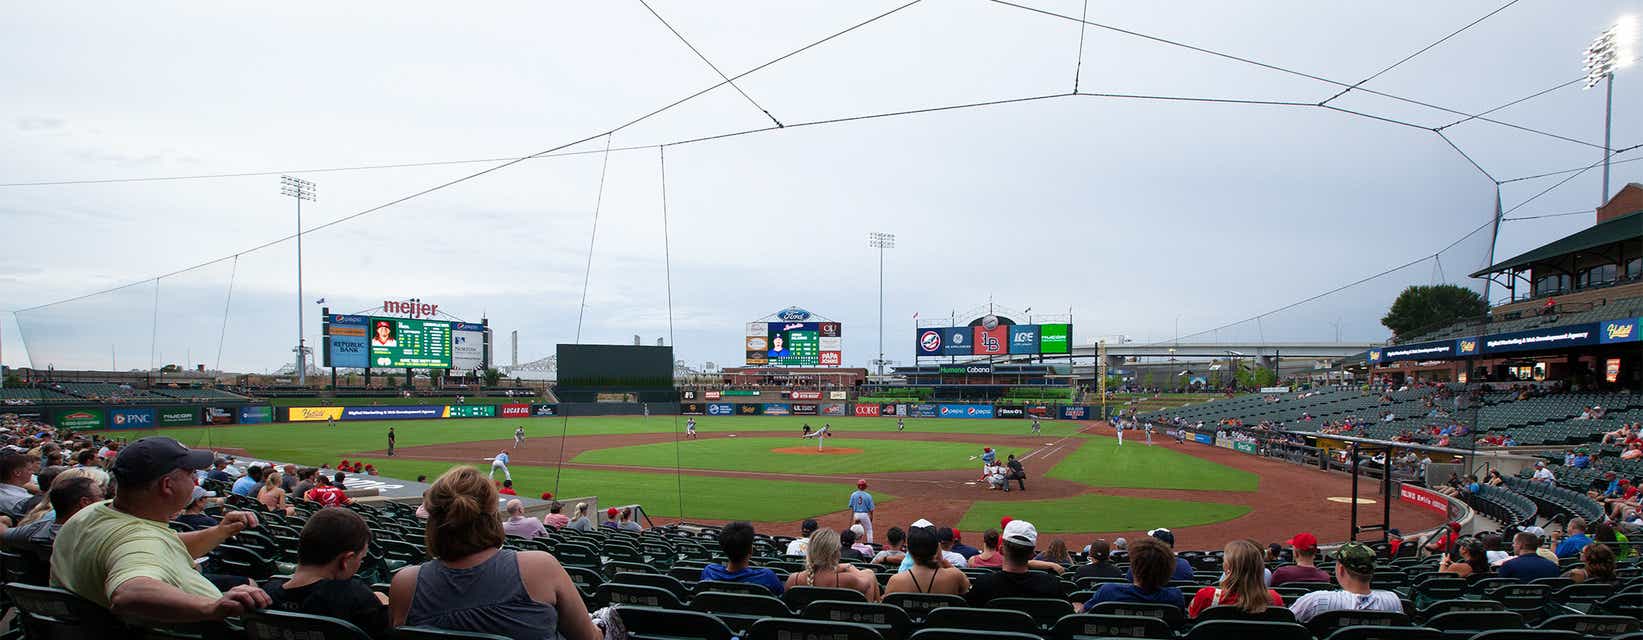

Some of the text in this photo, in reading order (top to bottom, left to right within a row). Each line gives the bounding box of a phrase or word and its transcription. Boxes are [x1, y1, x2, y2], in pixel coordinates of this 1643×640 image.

[384, 298, 438, 318] meijer
[783, 311, 804, 320] Ford
[941, 366, 990, 374] Humana Cabana
[856, 406, 879, 414] CORT
[127, 414, 151, 424] PNC
[858, 496, 863, 505] 3
